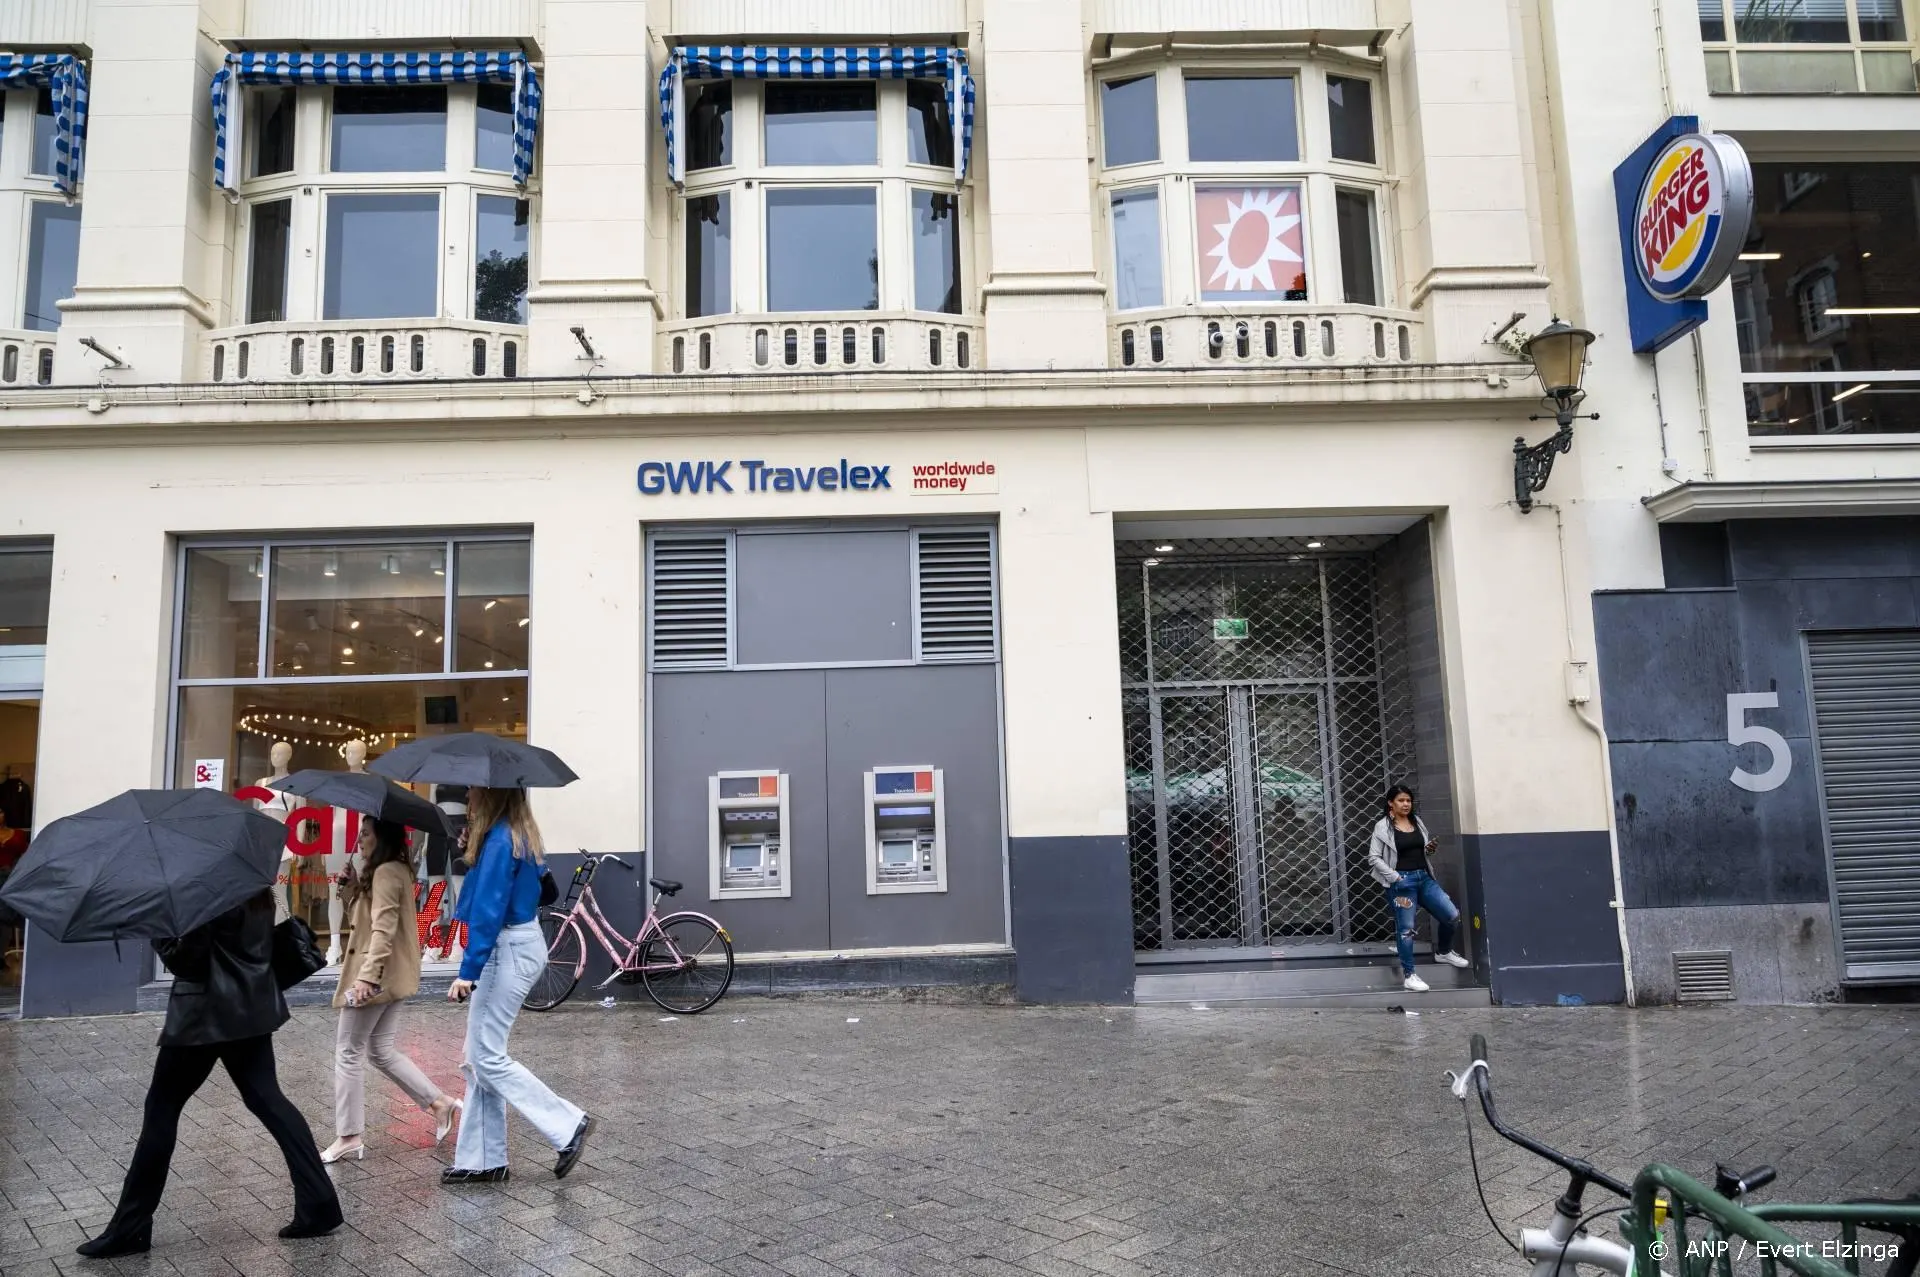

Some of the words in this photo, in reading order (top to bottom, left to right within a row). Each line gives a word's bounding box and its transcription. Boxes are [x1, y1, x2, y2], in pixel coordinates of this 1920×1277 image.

[1641, 147, 1704, 246] BURGER
[1645, 169, 1709, 281] KING
[637, 461, 733, 494] GWK
[740, 459, 892, 492] Travelex
[913, 461, 995, 476] worldwide
[914, 476, 967, 491] money
[1726, 692, 1792, 792] 5
